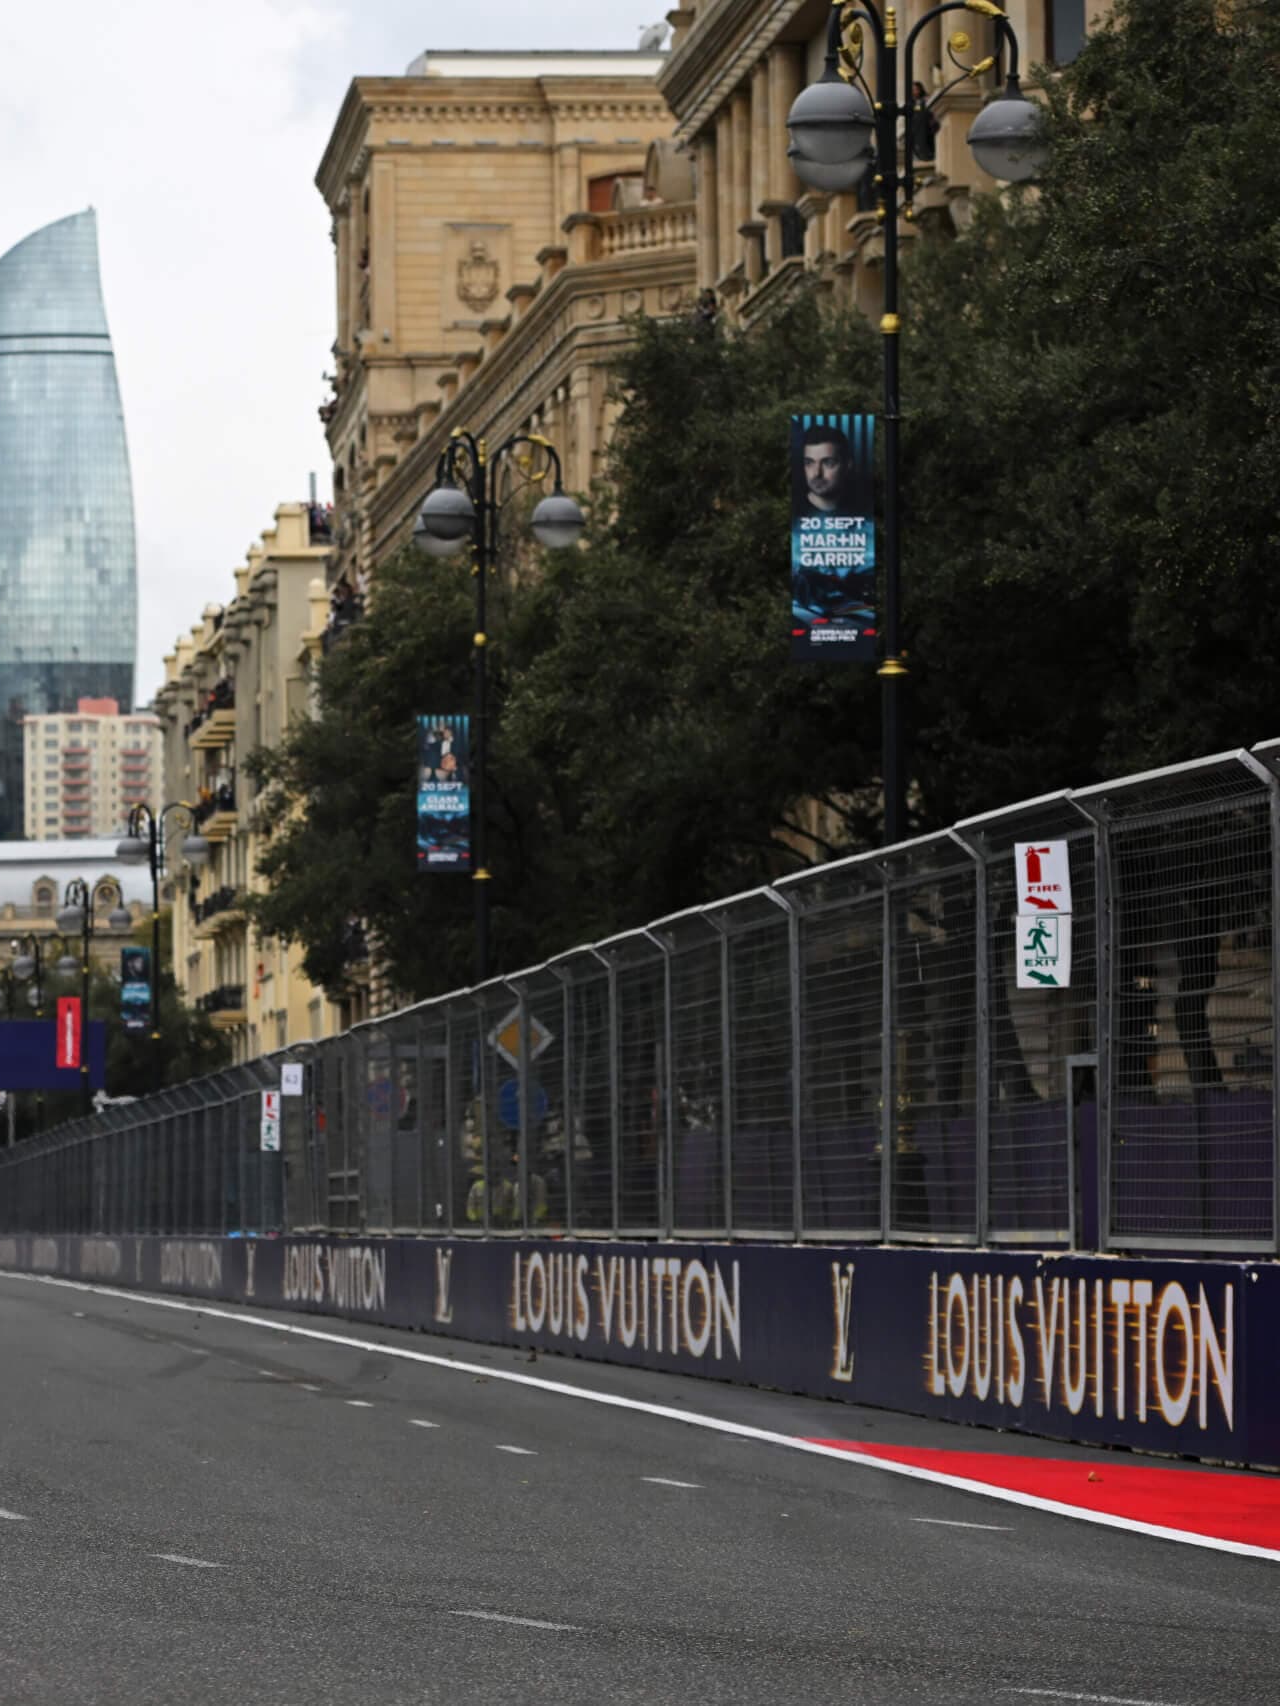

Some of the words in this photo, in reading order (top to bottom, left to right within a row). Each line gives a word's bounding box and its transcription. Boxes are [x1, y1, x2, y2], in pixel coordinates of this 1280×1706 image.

[800, 517, 821, 530] 20
[824, 517, 864, 530] SEPT
[800, 552, 866, 567] GARRIX
[1028, 884, 1062, 893] FIRE
[1024, 959, 1057, 967] EXIT
[283, 1243, 324, 1303] LOUIS
[326, 1245, 386, 1311] VUITTON
[513, 1251, 590, 1342] LOUIS
[597, 1255, 742, 1361] VUITTON
[930, 1270, 1025, 1407] LOUIS
[1034, 1276, 1234, 1433] VUITTON
